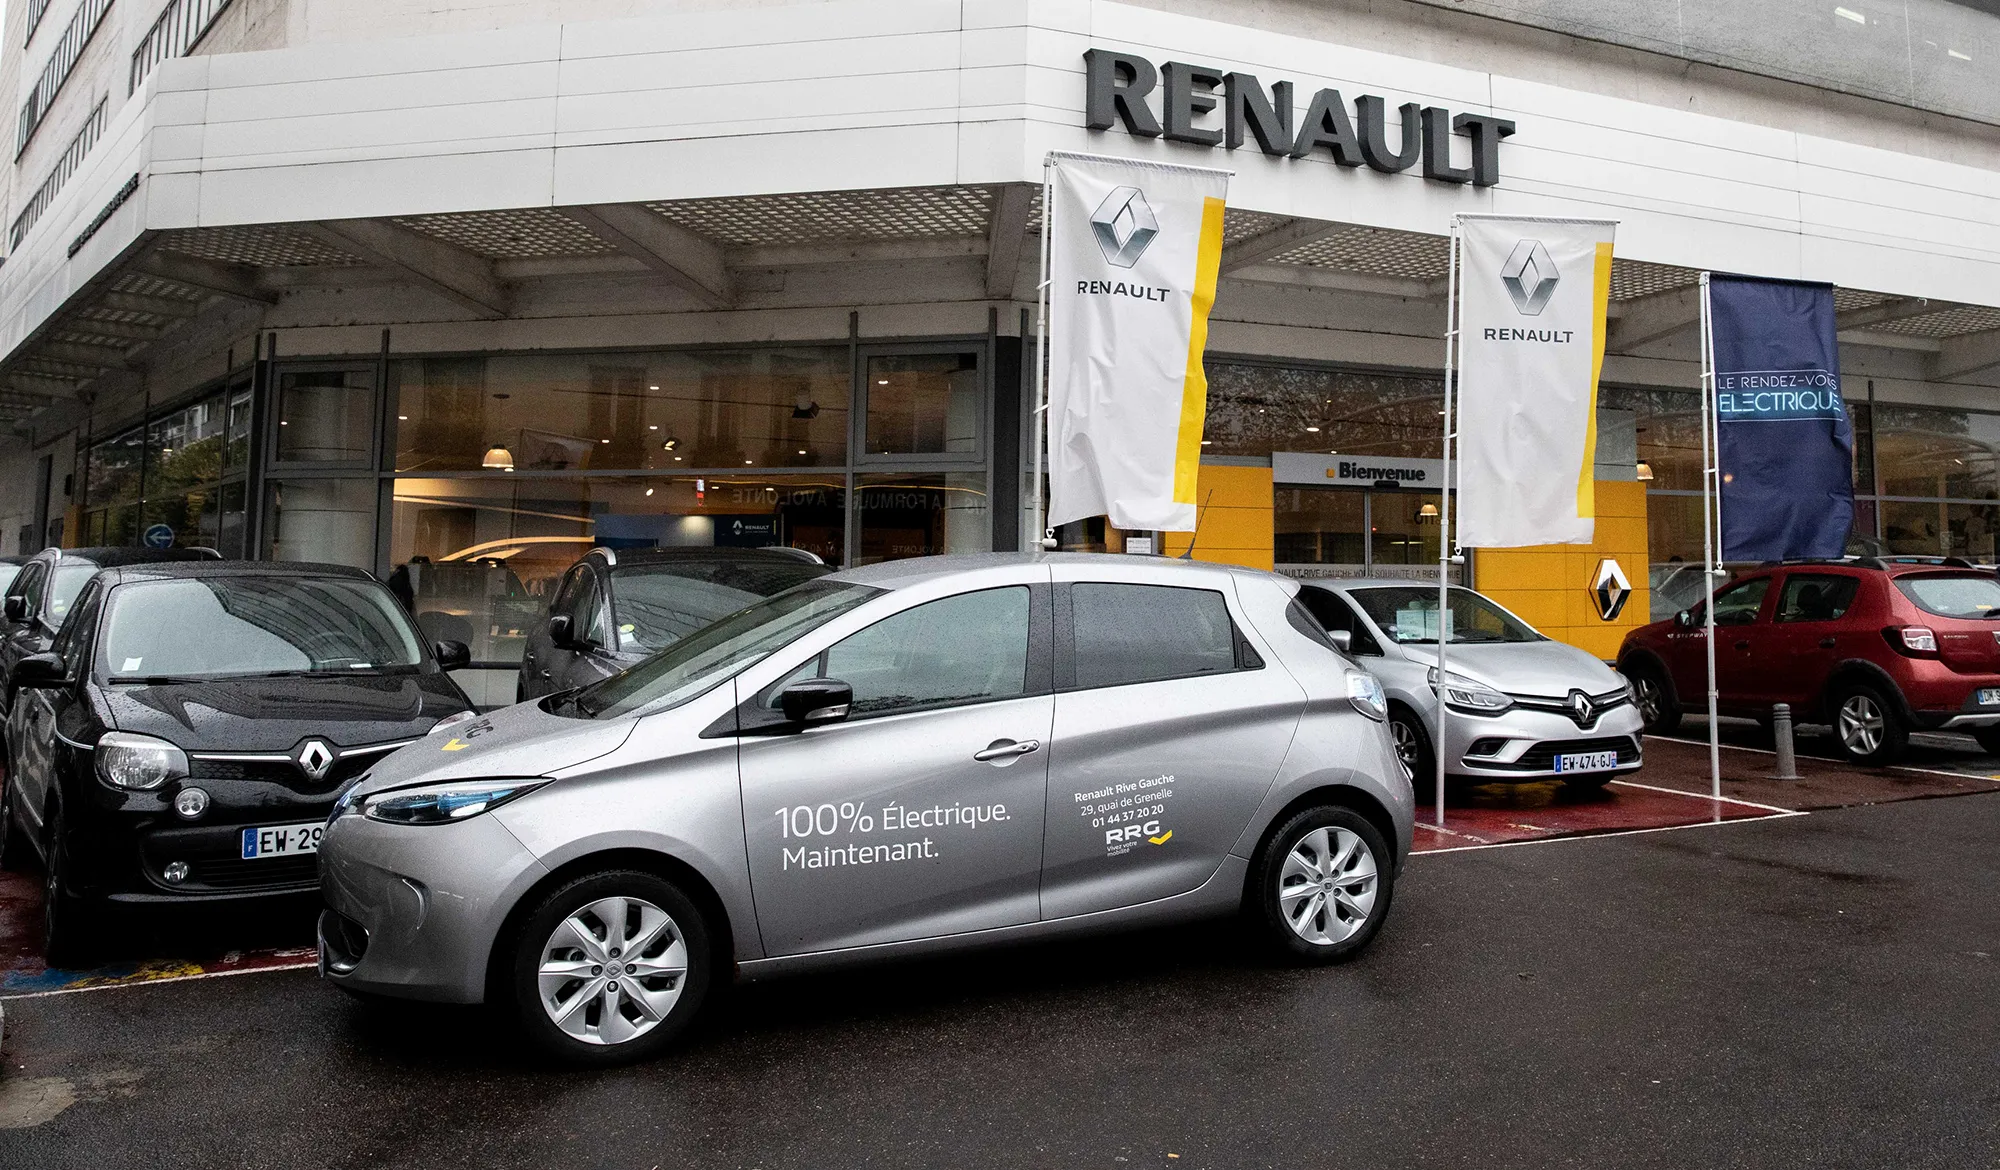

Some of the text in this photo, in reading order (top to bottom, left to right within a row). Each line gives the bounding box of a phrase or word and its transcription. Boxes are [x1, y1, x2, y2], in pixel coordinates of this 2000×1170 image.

[1082, 48, 1516, 187] RENAULT
[1077, 280, 1171, 302] RENAULT
[1484, 328, 1574, 343] RENAULT
[1718, 377, 1735, 389] LE
[1719, 391, 1841, 412] ELECTRIQUE
[1339, 461, 1426, 481] Bienvenue
[1304, 569, 1320, 578] RIVE
[1322, 569, 1352, 578] GAUCHE
[1562, 754, 1611, 770] EW-474-GJ
[1074, 774, 1175, 803] Renault Rive Gauche
[1081, 788, 1173, 816] 29, quai de Grenelle
[775, 801, 1011, 839] 100% Électrique.
[1092, 804, 1164, 828] 01 44 37 20 20
[1105, 820, 1160, 845] RRG
[783, 837, 940, 870] Maintenant.
[1106, 847, 1130, 857] mobilité
[1122, 841, 1138, 849] votre
